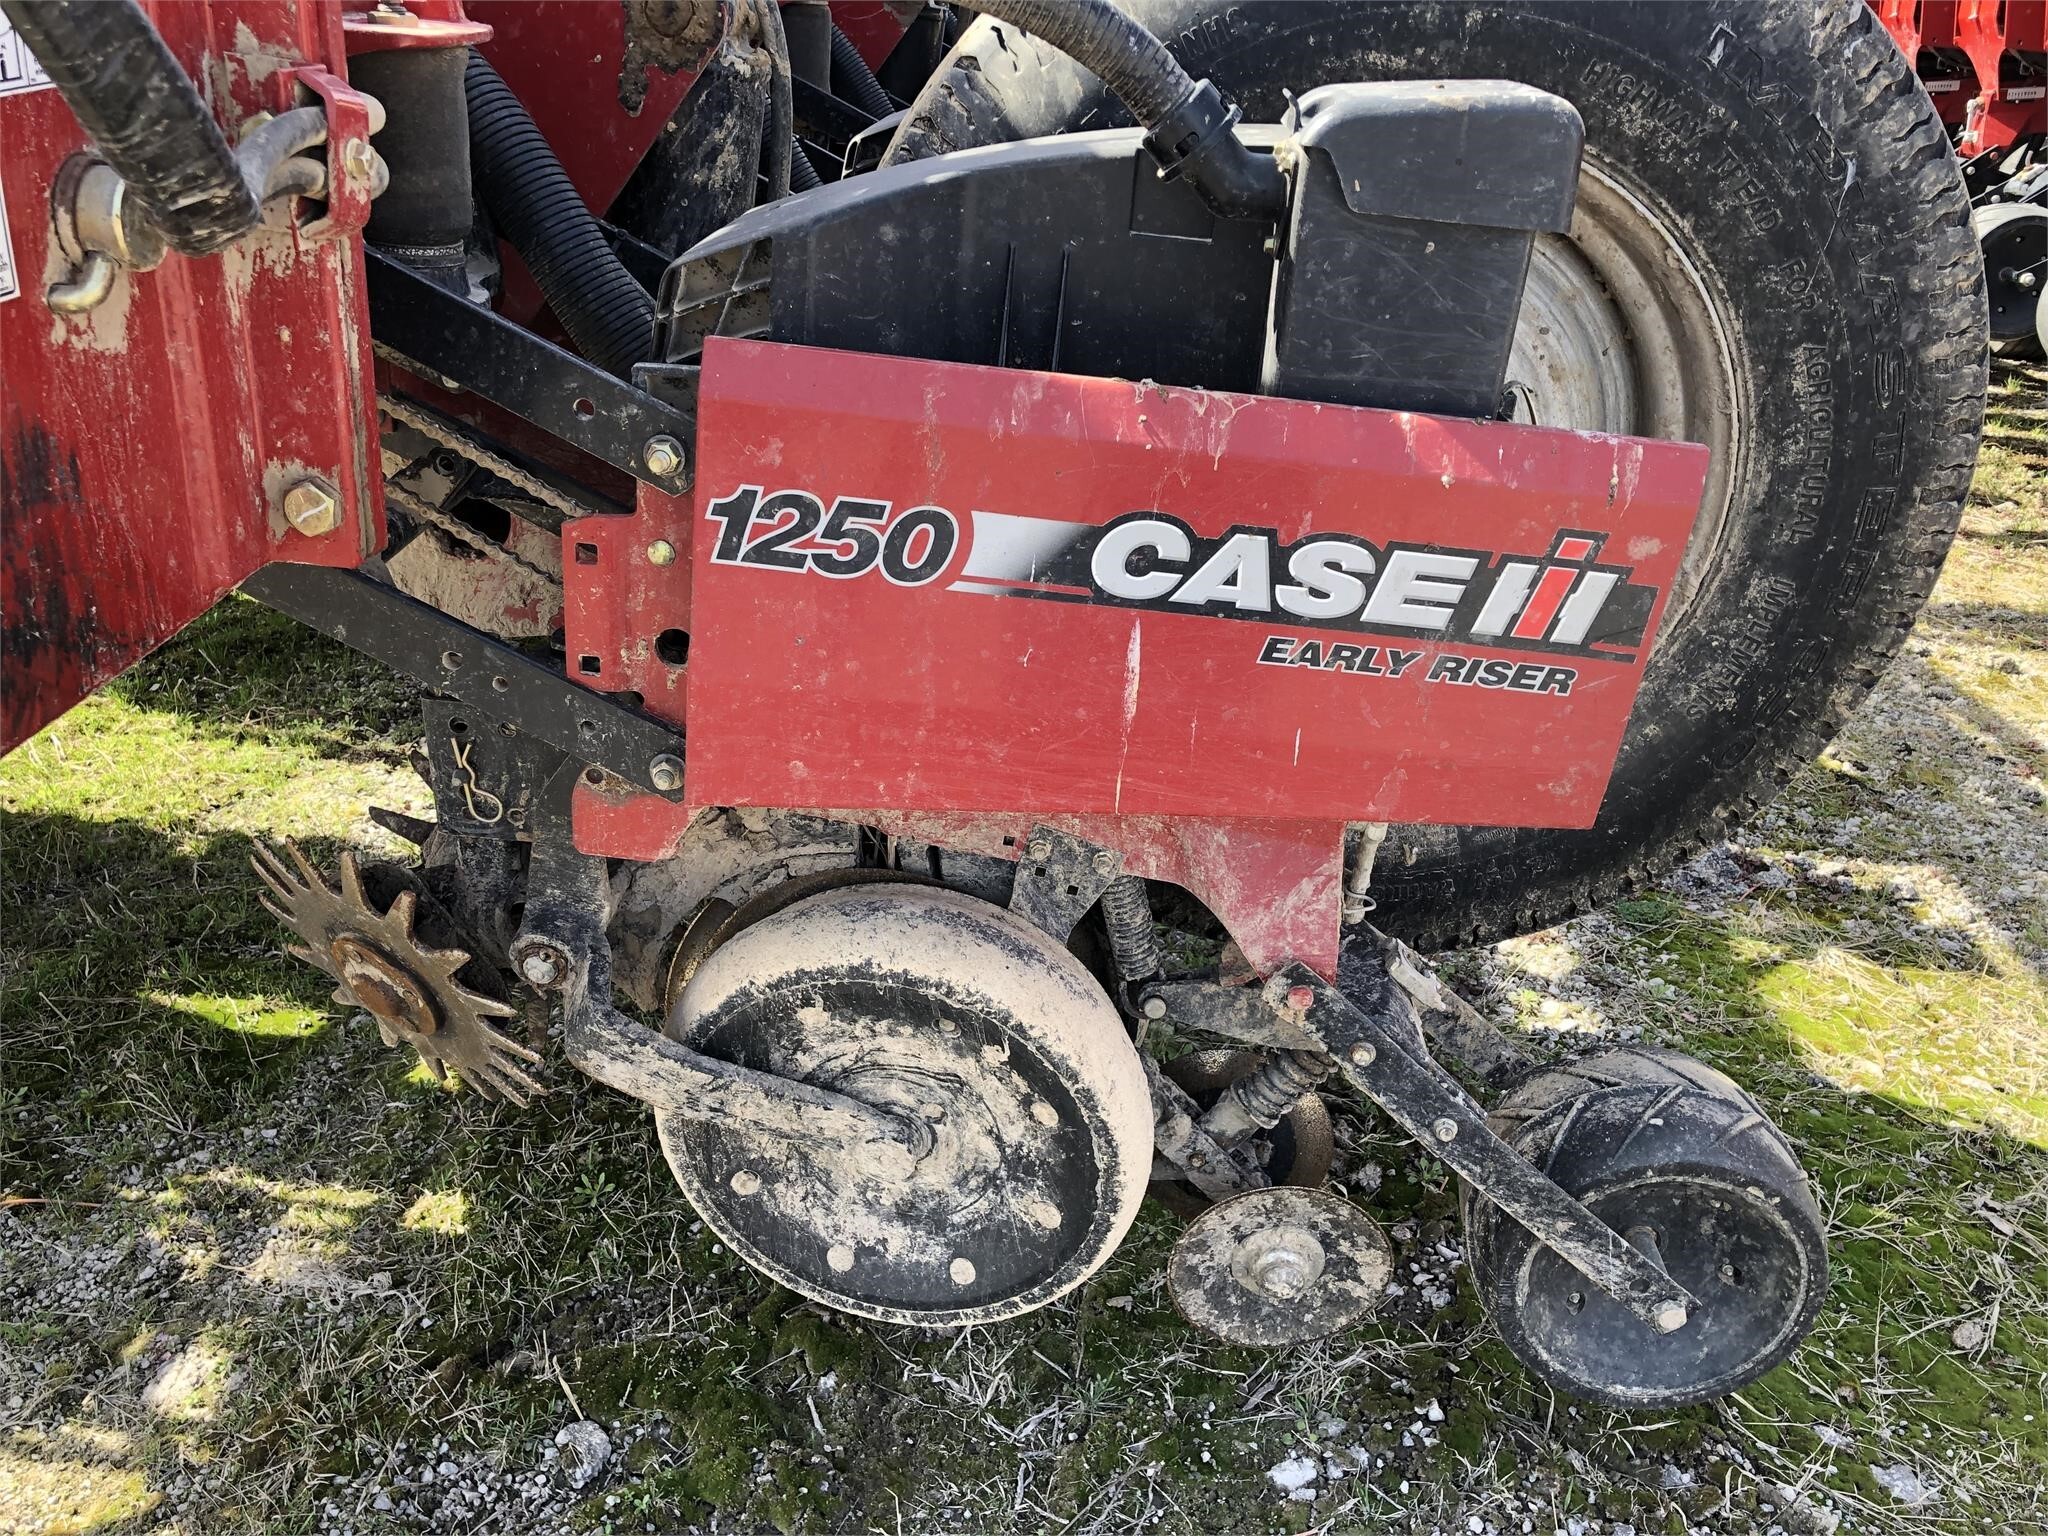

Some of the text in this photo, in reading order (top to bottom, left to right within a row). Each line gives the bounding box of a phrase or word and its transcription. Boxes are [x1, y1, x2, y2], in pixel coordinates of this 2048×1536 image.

[1579, 57, 1834, 719] HIGHWAY TREAD FOR AGRICULTURAL IMPLEMENTS
[705, 484, 959, 587] 1250
[1090, 518, 1480, 630] CASE
[1256, 635, 1579, 697] EARLY RISER
